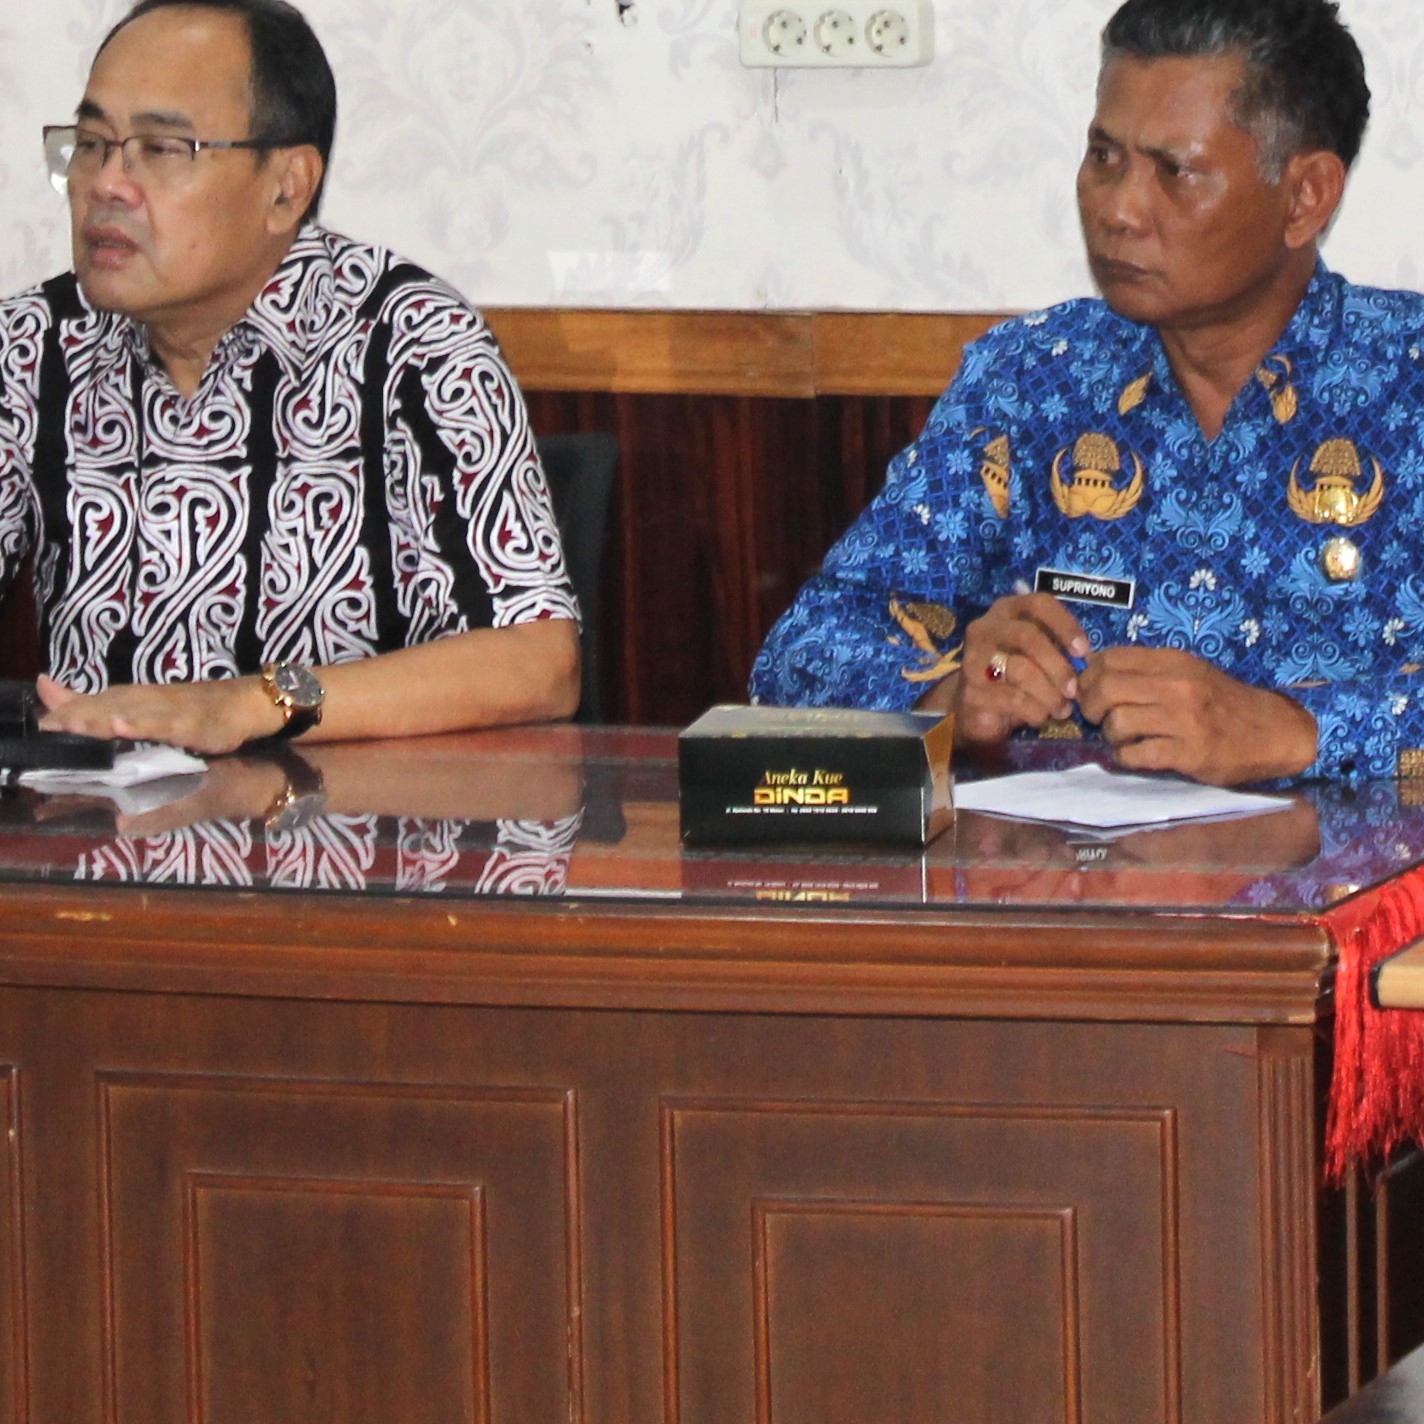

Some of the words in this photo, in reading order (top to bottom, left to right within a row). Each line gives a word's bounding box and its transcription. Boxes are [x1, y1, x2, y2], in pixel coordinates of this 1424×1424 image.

[1052, 577, 1116, 598] SUPRIYONO
[760, 768, 808, 786] Aneka
[812, 770, 844, 786] Kue
